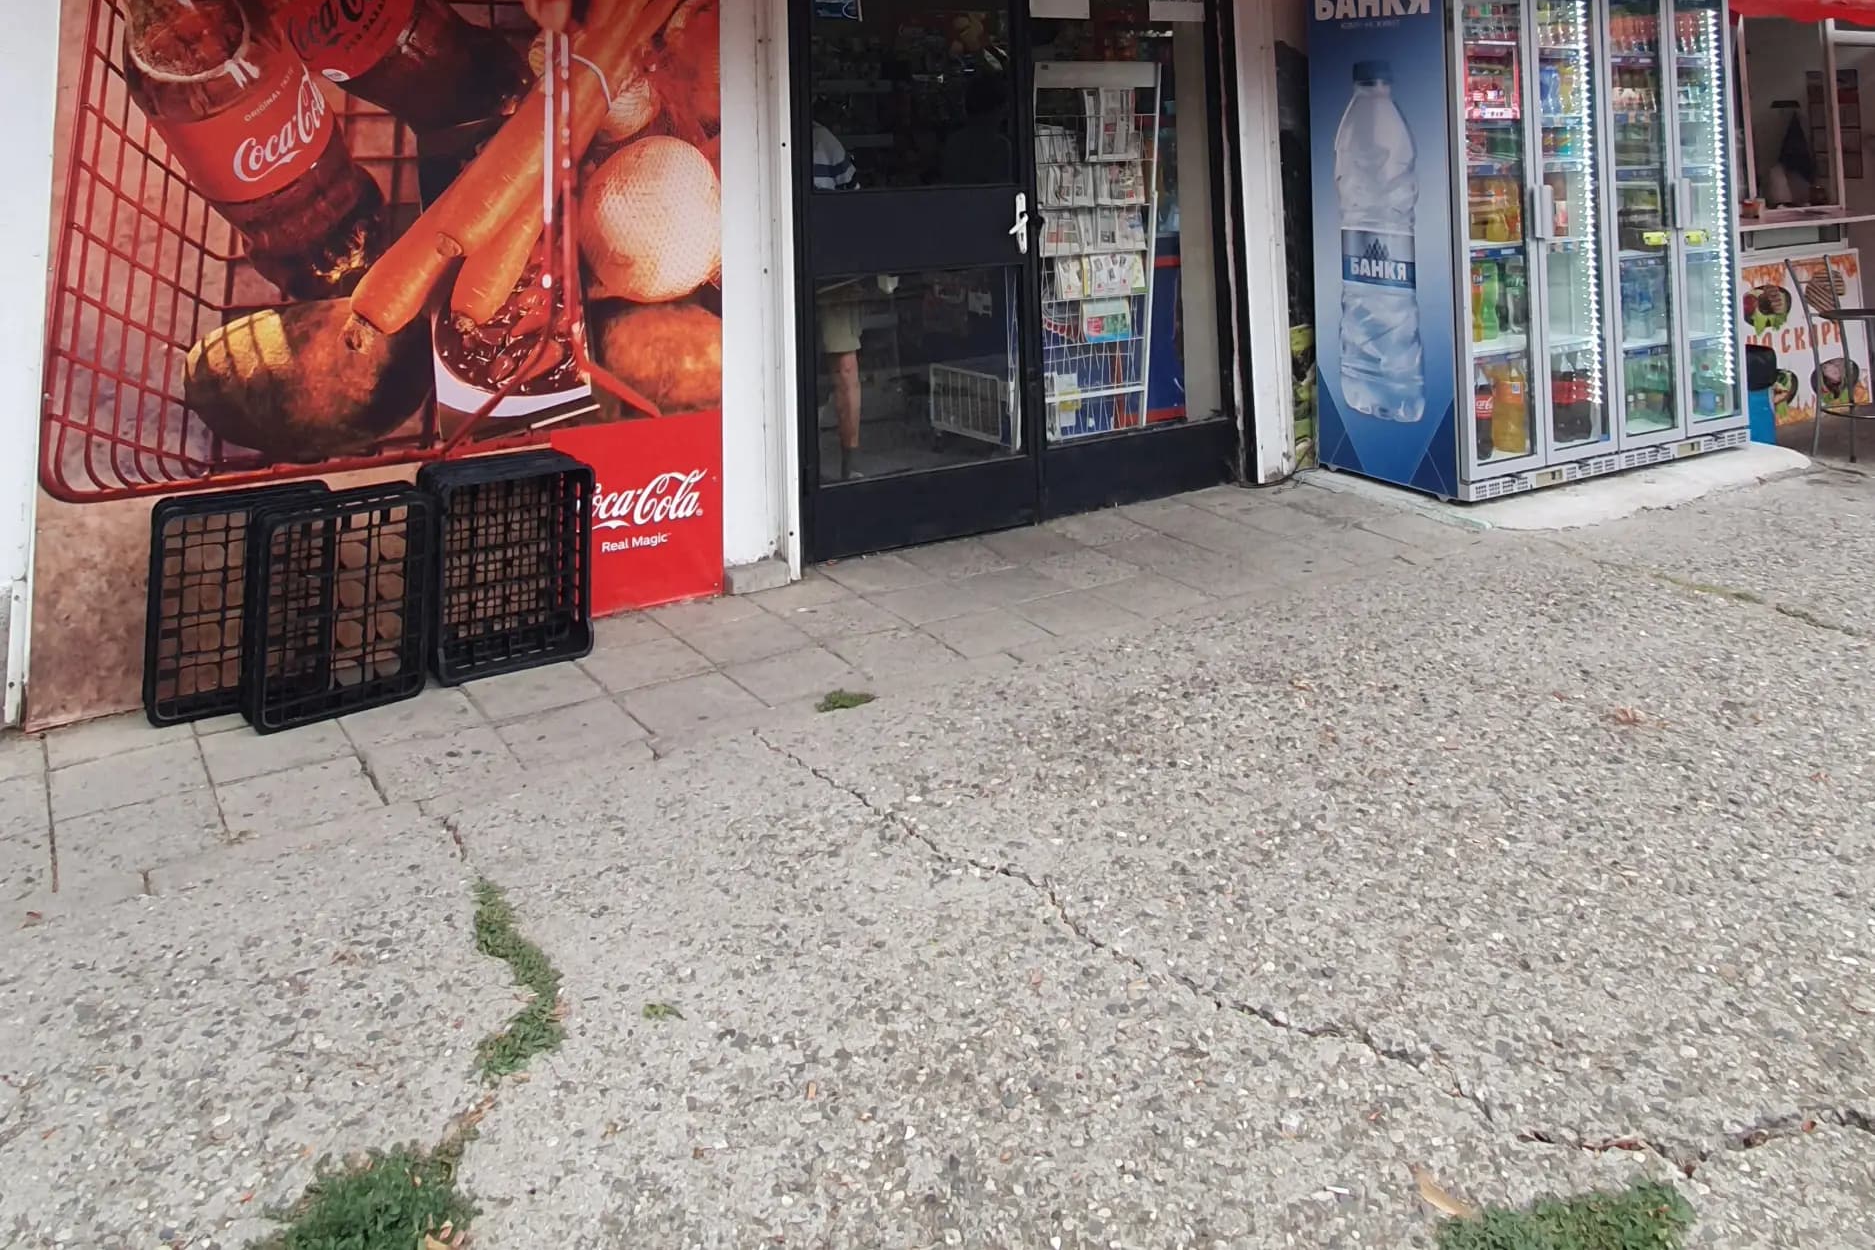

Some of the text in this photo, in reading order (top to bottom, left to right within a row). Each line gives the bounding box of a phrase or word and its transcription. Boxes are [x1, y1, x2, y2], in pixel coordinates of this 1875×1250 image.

[1350, 256, 1407, 281] БАНКЯ
[592, 468, 708, 530] oca-Cola
[601, 533, 669, 553] Real Magic
